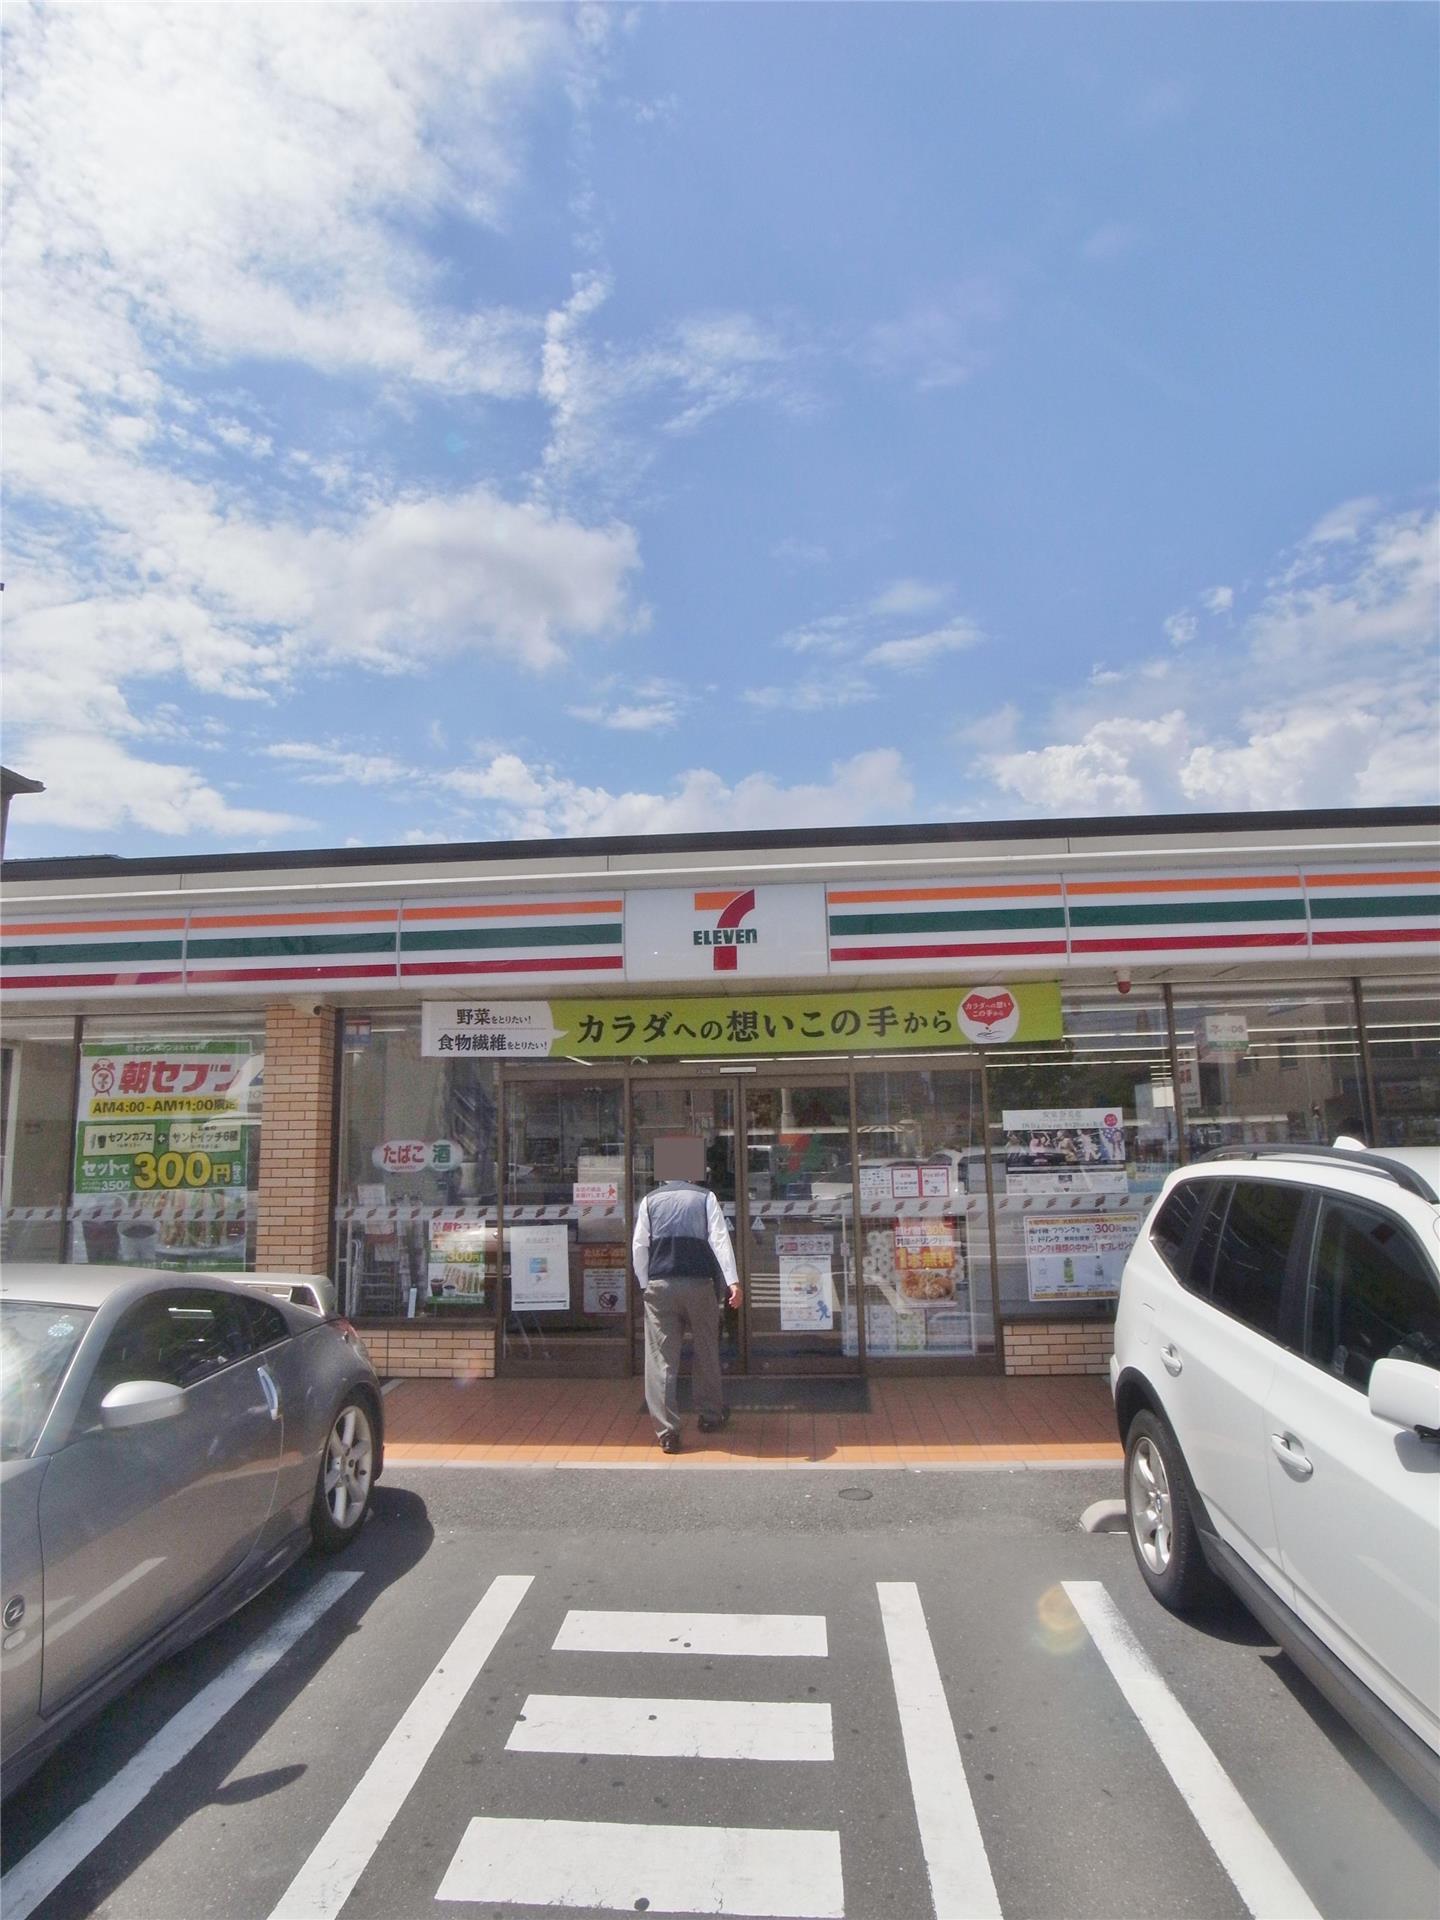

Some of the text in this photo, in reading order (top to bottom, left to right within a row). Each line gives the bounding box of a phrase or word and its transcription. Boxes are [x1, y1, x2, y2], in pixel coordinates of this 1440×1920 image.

[576, 1005, 953, 1044] カラダへの想いこの手から
[118, 1060, 240, 1094] 朝セブン
[81, 1159, 130, 1177] セットで
[133, 1151, 232, 1190] 300円
[383, 1144, 451, 1164] たばこ 酒
